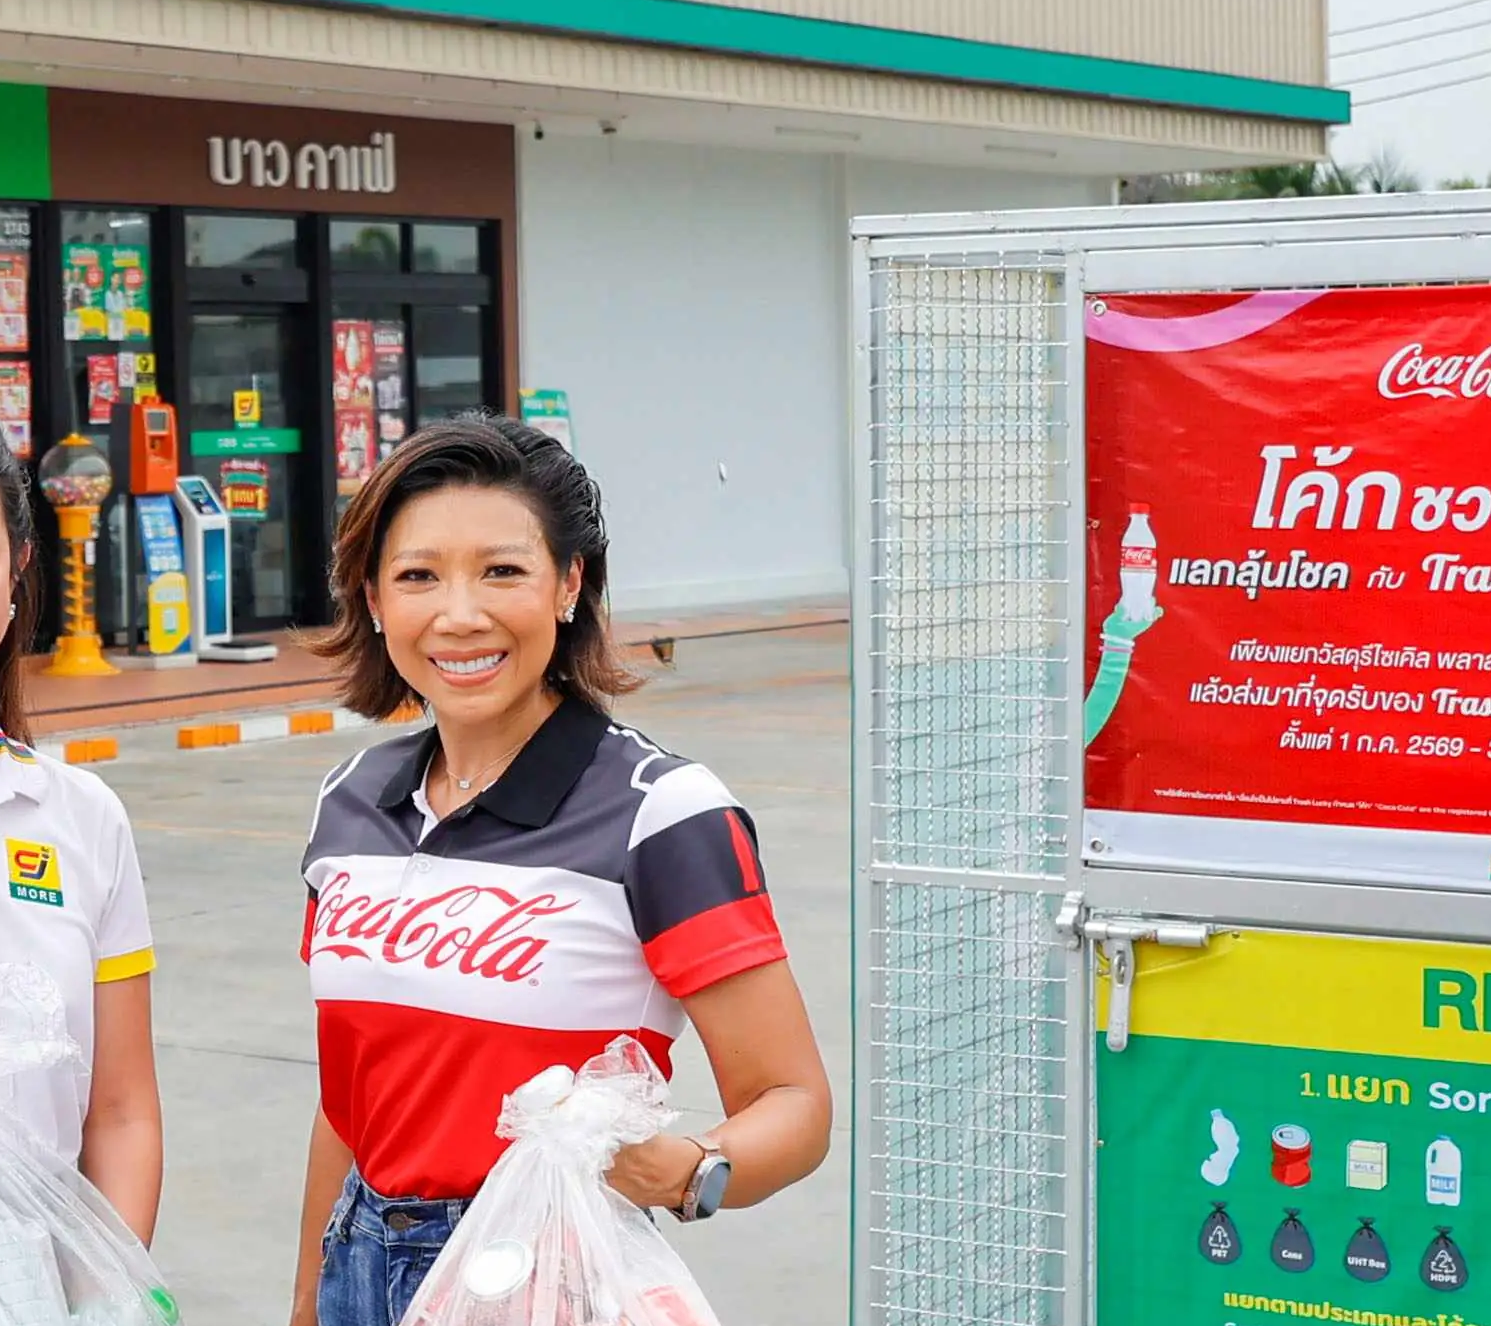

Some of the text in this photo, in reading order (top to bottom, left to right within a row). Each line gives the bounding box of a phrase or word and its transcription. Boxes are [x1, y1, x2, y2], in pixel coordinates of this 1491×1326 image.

[207, 132, 397, 194] บาว คาเฟ่
[1251, 446, 1401, 531] โค้ก
[1170, 550, 1350, 601] แลกลุ้นโชค
[1367, 566, 1404, 590] กับ
[1279, 724, 1335, 752] ตั้งแต่
[1340, 734, 1349, 752] 1
[1356, 735, 1398, 755] ก.ค.
[1407, 736, 1464, 757] 2569
[17, 886, 58, 903] MORE
[1431, 1177, 1456, 1192] MILK
[1281, 1249, 1303, 1261] Cans
[1347, 1257, 1386, 1269] UHT Box
[1430, 1273, 1457, 1284] HDPE
